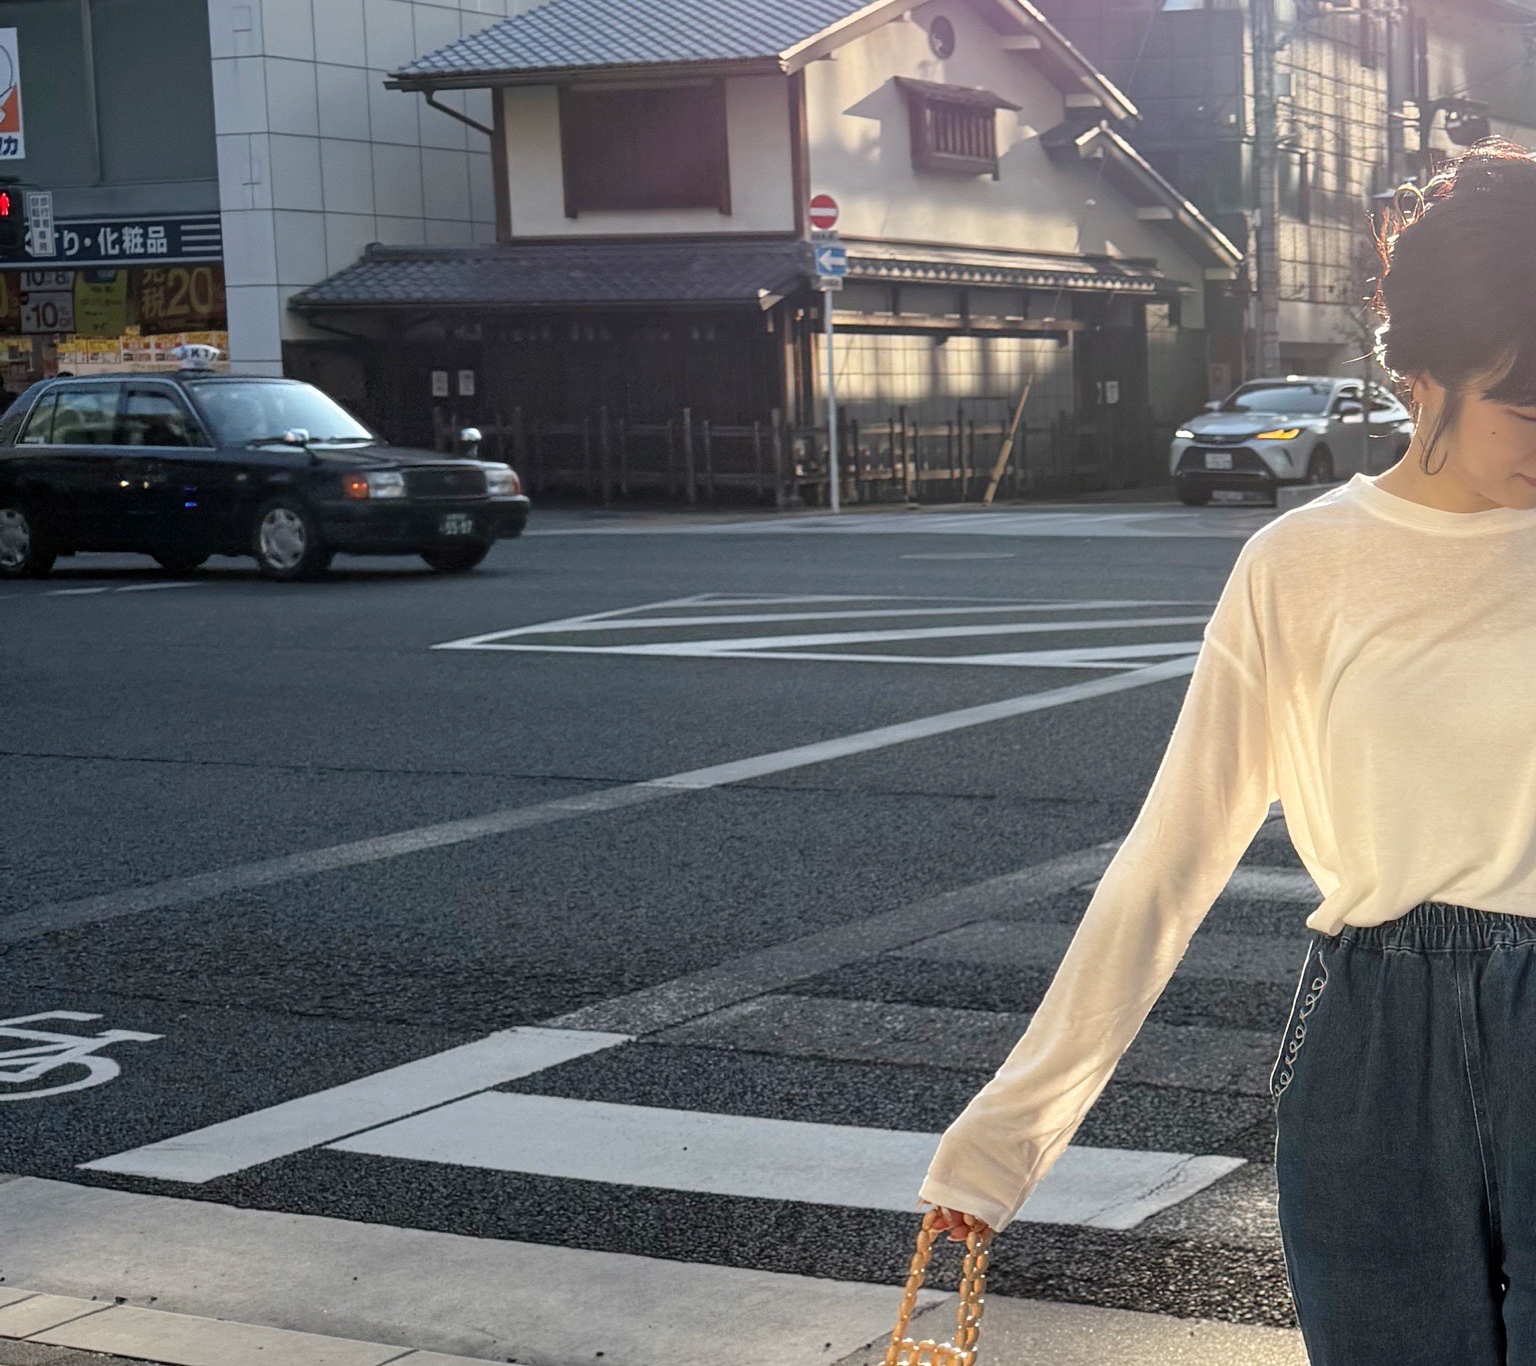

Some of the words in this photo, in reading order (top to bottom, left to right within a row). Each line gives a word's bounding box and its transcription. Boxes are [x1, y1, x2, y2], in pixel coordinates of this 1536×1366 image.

[25, 225, 168, 256] り・化粧品
